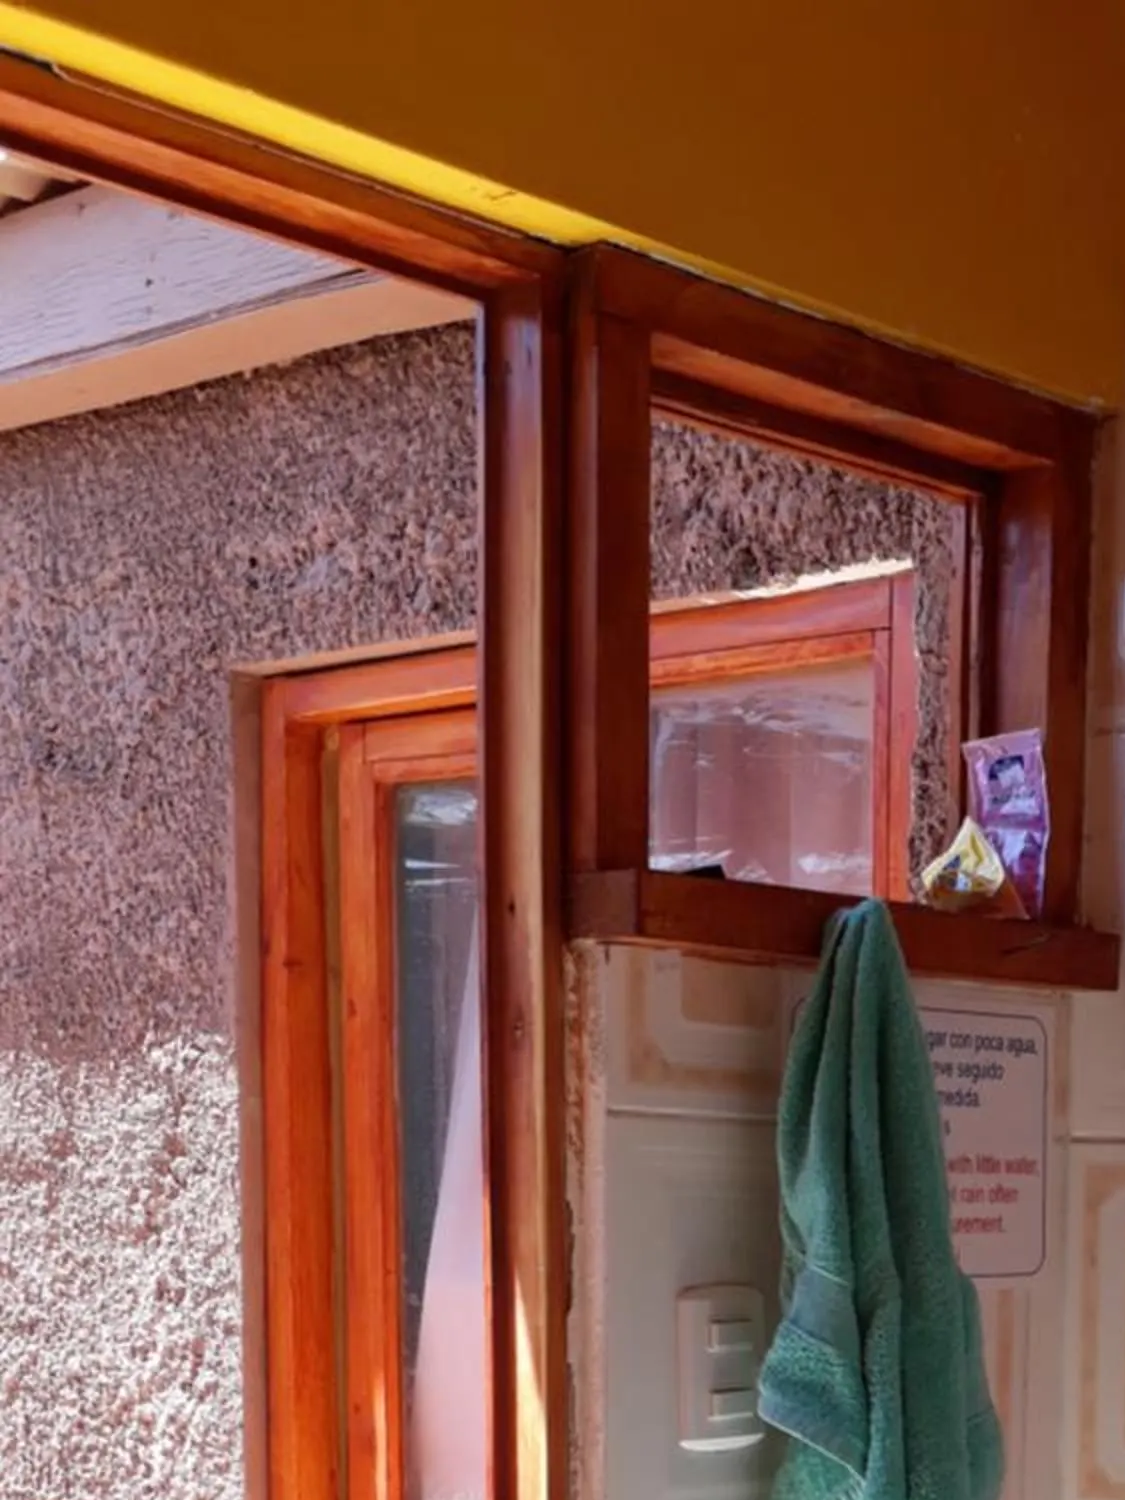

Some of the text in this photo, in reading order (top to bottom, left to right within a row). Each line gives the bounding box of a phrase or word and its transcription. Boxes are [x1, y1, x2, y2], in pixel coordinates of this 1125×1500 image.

[926, 1028, 947, 1052] gar
[949, 1030, 973, 1049] con
[974, 1032, 1004, 1054] poca
[956, 1060, 1005, 1084] seguido
[988, 1183, 1020, 1204] often
